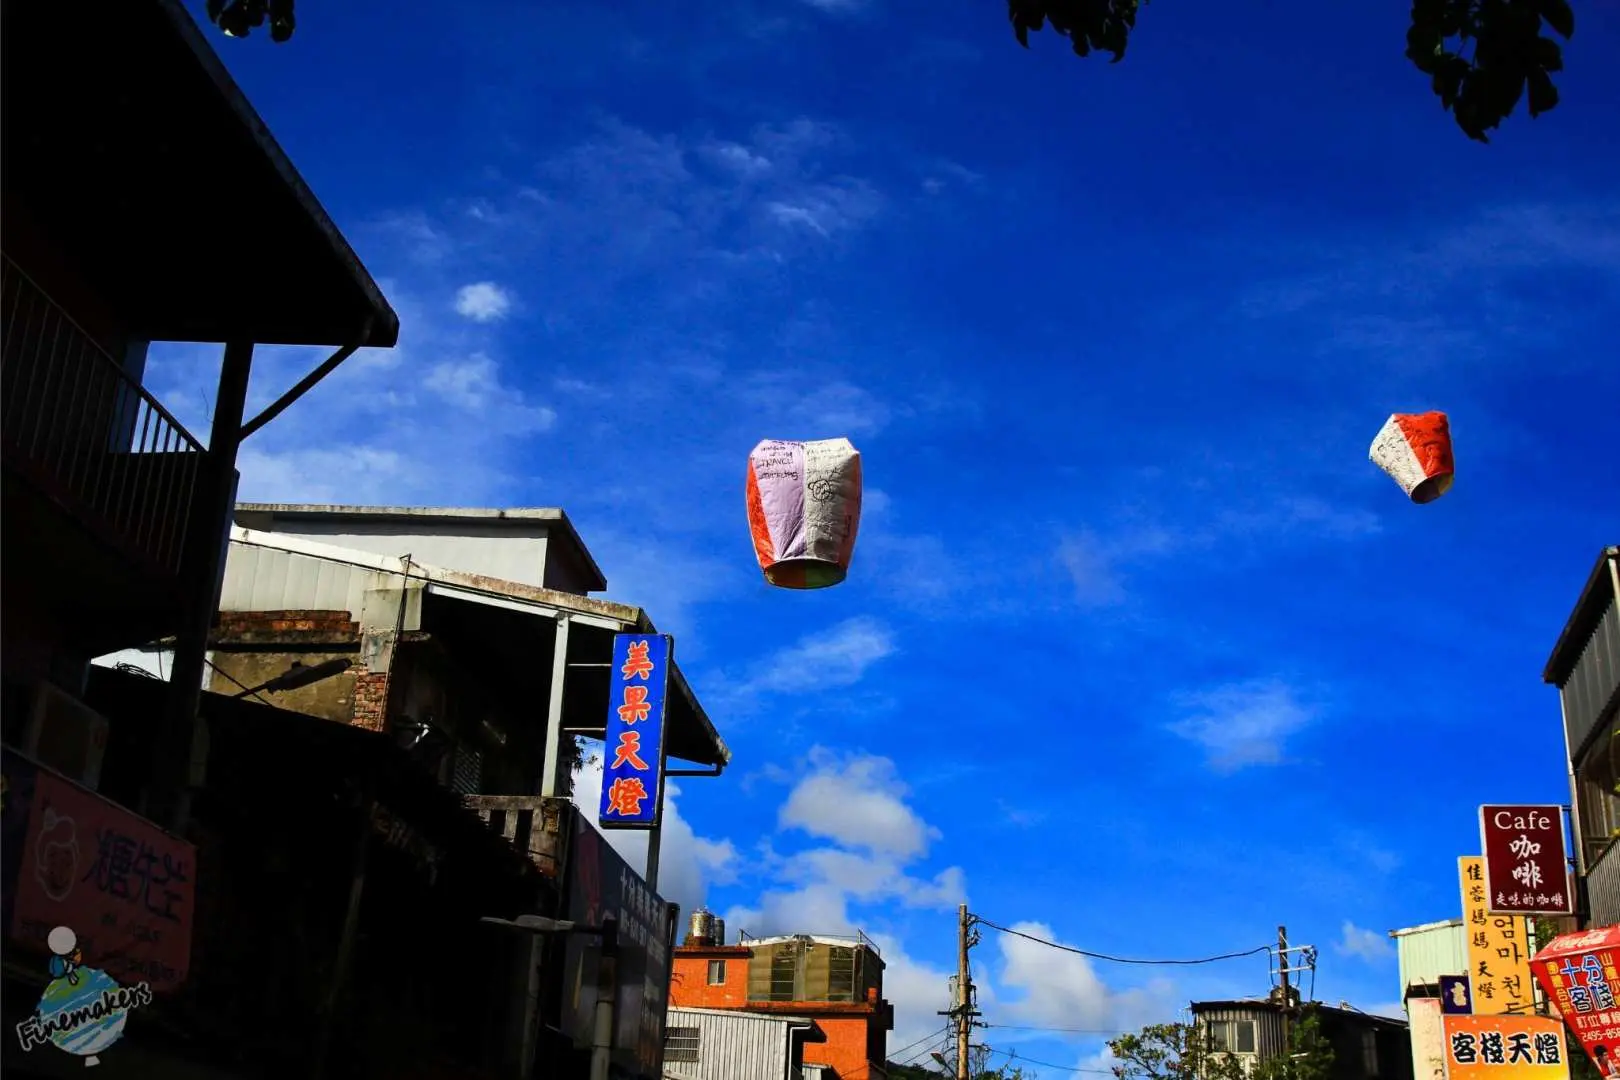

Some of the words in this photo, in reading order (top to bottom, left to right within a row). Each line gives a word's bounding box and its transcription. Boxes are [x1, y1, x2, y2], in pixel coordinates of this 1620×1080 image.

[606, 639, 654, 817] 美果天燈
[1493, 810, 1552, 830] Cafe
[1508, 834, 1545, 889] 咖啡
[1495, 891, 1564, 907] 走味的咖啡
[1561, 954, 1604, 987] 十分
[1451, 1031, 1562, 1065] 客棧天燈
